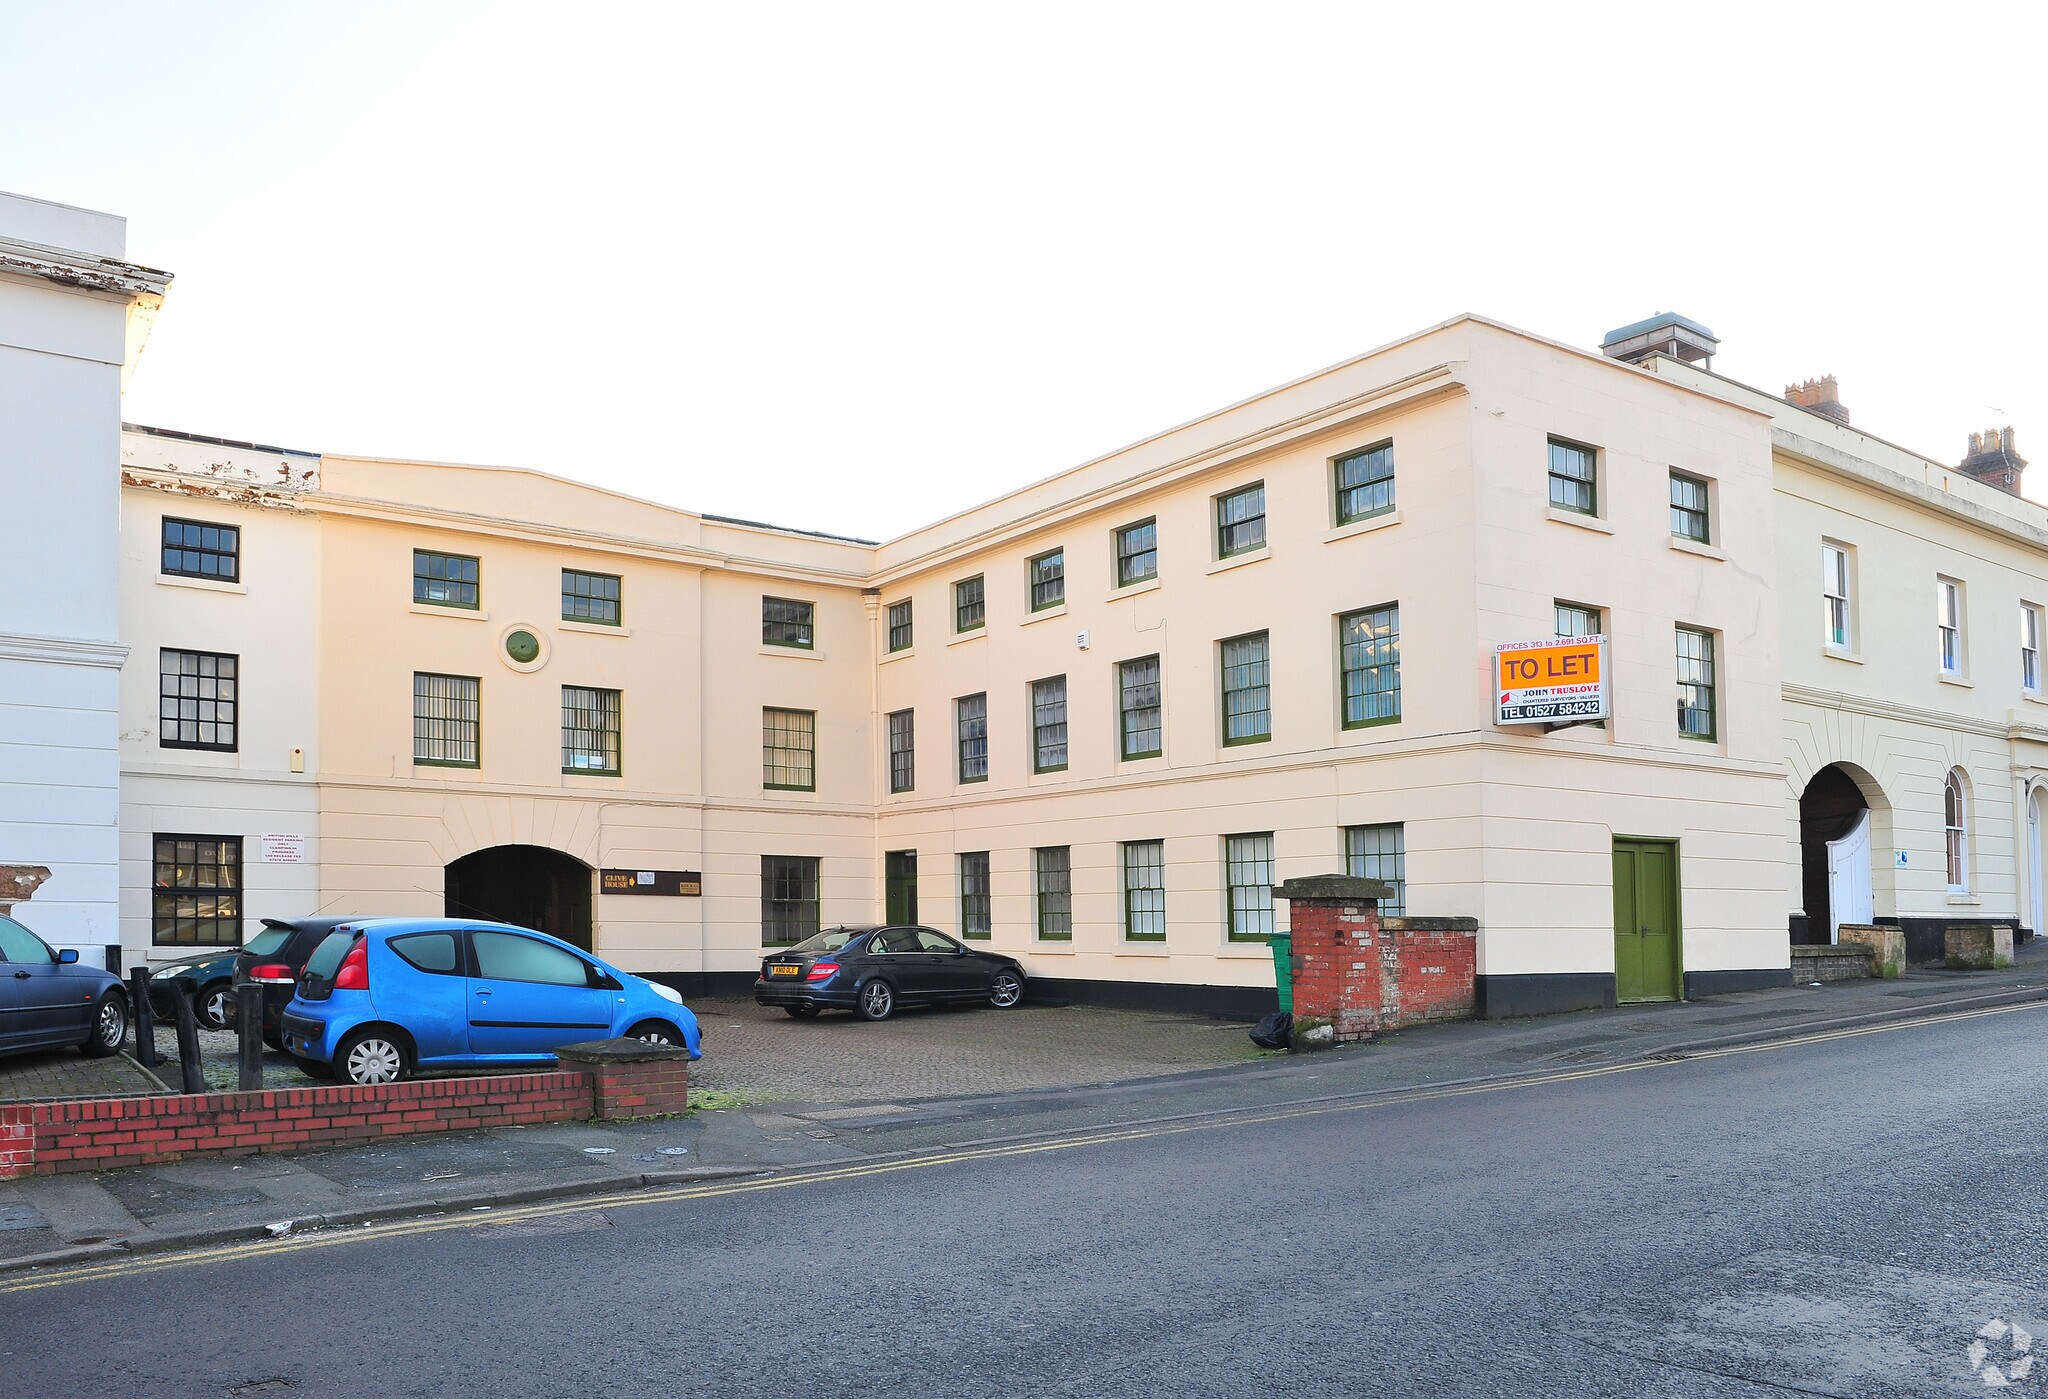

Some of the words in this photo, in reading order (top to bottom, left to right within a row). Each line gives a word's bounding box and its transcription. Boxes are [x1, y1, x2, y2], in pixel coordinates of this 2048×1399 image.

[1496, 643, 1529, 651] OFFICES
[1555, 638, 1575, 646] 2,691
[1505, 658, 1539, 680] TO
[1547, 653, 1595, 677] LET
[1522, 689, 1549, 697] JOHN
[1550, 685, 1600, 695] TRUSLOVE
[1503, 706, 1524, 719] TEL
[1526, 704, 1557, 717] 01527
[1559, 701, 1599, 715] 584242
